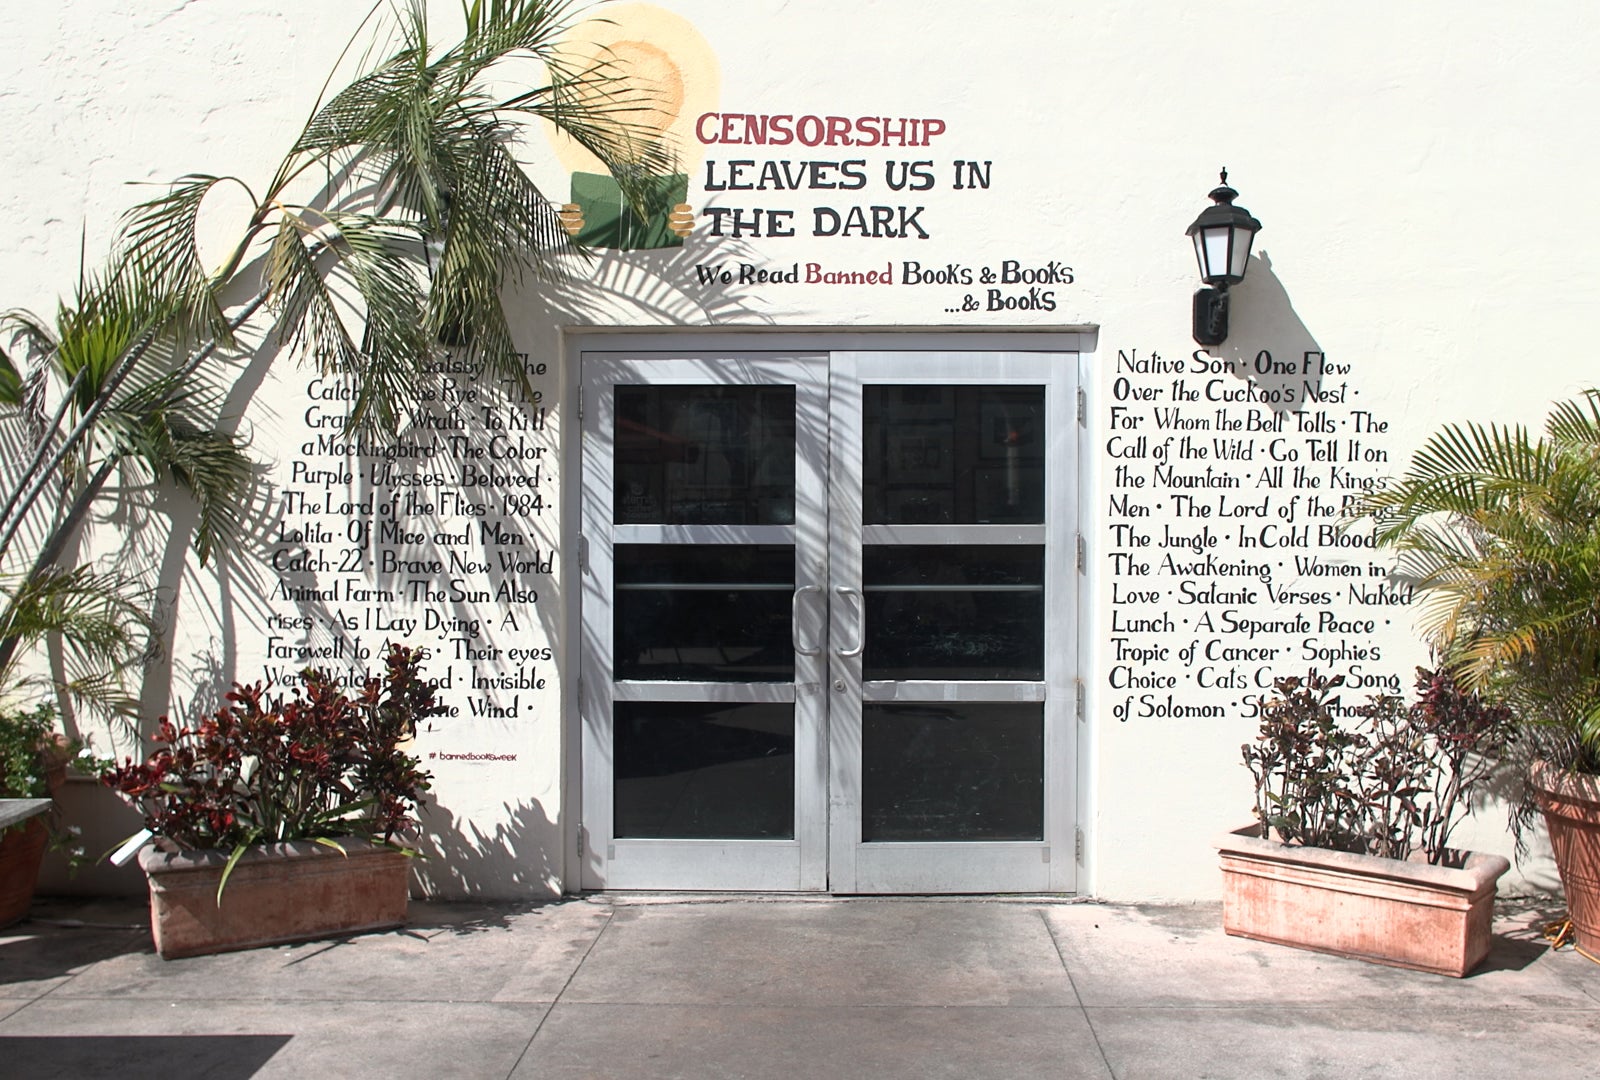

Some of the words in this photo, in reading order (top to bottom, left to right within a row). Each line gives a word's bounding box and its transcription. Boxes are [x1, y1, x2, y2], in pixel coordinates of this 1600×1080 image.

[695, 112, 946, 147] CENSORSHIP
[704, 160, 867, 191] LEAVES
[885, 160, 935, 191] US
[953, 160, 992, 190] IN
[703, 207, 795, 238] THE
[813, 206, 929, 239] DARK
[696, 264, 732, 286] We
[739, 263, 799, 285] Read
[805, 262, 893, 285] Banned
[902, 260, 973, 286] Books
[979, 266, 997, 285] &
[1001, 260, 1074, 286] Books
[944, 294, 980, 313] ...&
[987, 288, 1056, 312] Books
[1116, 348, 1185, 374] Native
[1190, 349, 1235, 374] Son
[1254, 350, 1297, 375] One
[1302, 351, 1351, 375] Flew
[442, 378, 477, 413] Rye
[1113, 377, 1163, 401] Over
[1171, 379, 1199, 401] the
[1205, 379, 1295, 404] Cuckoo's
[1301, 380, 1348, 404] Nest
[409, 406, 465, 430] Wrath
[481, 406, 502, 430] To
[509, 407, 545, 431] Kill
[1110, 406, 1144, 430] For
[1154, 407, 1210, 431] Whom
[1215, 409, 1242, 431] the
[1246, 409, 1283, 432] Bell
[1292, 411, 1335, 433] Tolls
[1350, 411, 1388, 433] The
[301, 440, 314, 456] a
[317, 434, 436, 463] Mockingbird
[447, 435, 484, 459] The
[489, 436, 547, 460] Color
[1106, 436, 1147, 459] Call
[1152, 436, 1174, 466] of
[1179, 437, 1207, 460] the
[1212, 438, 1253, 461] Wild
[1269, 438, 1298, 462] Go
[1305, 439, 1338, 462] Tell
[1348, 439, 1361, 462] It
[1364, 448, 1387, 462] on
[292, 461, 353, 490] Purple
[370, 463, 444, 492] Ulysses
[461, 464, 539, 487] Beloved
[1115, 465, 1145, 488] the
[1153, 465, 1240, 488] Mountain
[1256, 467, 1283, 488] All
[1293, 466, 1320, 489] the
[1330, 467, 1387, 495] King's
[282, 491, 320, 515] The
[325, 493, 374, 515] Lord
[379, 493, 401, 524] of
[405, 491, 434, 515] the
[439, 492, 486, 516] Flies
[502, 494, 544, 517] 1984
[1108, 494, 1149, 517] Men
[1170, 494, 1211, 518] The
[1218, 495, 1268, 518] Lord
[1278, 495, 1298, 522] of
[1308, 495, 1335, 517] the
[279, 520, 332, 543] Lolita
[347, 519, 372, 549] Of
[380, 521, 424, 544] Mice
[433, 522, 469, 545] and
[480, 520, 523, 545] Men
[1109, 524, 1150, 547] The
[1158, 524, 1217, 554] Jungle
[1238, 525, 1256, 548] In
[1259, 525, 1309, 548] Cold
[1318, 525, 1377, 549] Blood
[272, 548, 363, 573] Catch-22
[382, 550, 442, 574] Brave
[449, 551, 491, 574] New
[497, 550, 553, 575] World
[1108, 553, 1150, 576] The
[1157, 552, 1271, 583] Awakening
[1294, 555, 1361, 577] Women
[1368, 562, 1386, 577] in
[269, 578, 339, 601] Animal
[346, 579, 394, 602] Farm
[407, 579, 446, 602] The
[449, 579, 490, 603] Sun
[495, 580, 538, 604] Also
[1112, 582, 1160, 604] Love
[1177, 580, 1257, 605] Satanic
[1266, 584, 1331, 605] Verses
[1349, 583, 1413, 606] Naked
[267, 614, 313, 629] rises
[329, 608, 358, 631] As
[365, 608, 370, 630] I
[375, 608, 417, 637] Lay
[425, 608, 479, 640] Dying
[500, 610, 520, 632] A
[1111, 610, 1175, 633] Lunch
[1194, 610, 1215, 633] A
[1221, 609, 1311, 639] Separate
[1318, 611, 1375, 633] Peace
[267, 636, 343, 660] Farewell
[354, 636, 370, 660] to
[377, 636, 431, 660] As
[449, 637, 501, 661] Their
[508, 647, 552, 666] eyes
[1110, 637, 1169, 665] Tropic
[1178, 639, 1199, 667] of
[1205, 639, 1279, 661] Cancer
[1301, 637, 1380, 668] Sophie's
[412, 666, 452, 689] od
[471, 666, 546, 690] Invisible
[1108, 665, 1176, 690] Choice
[1197, 665, 1247, 690] Cat's
[1345, 665, 1400, 694] Song
[467, 695, 519, 718] Wind
[1113, 695, 1134, 721] of
[1138, 694, 1225, 718] Solomon
